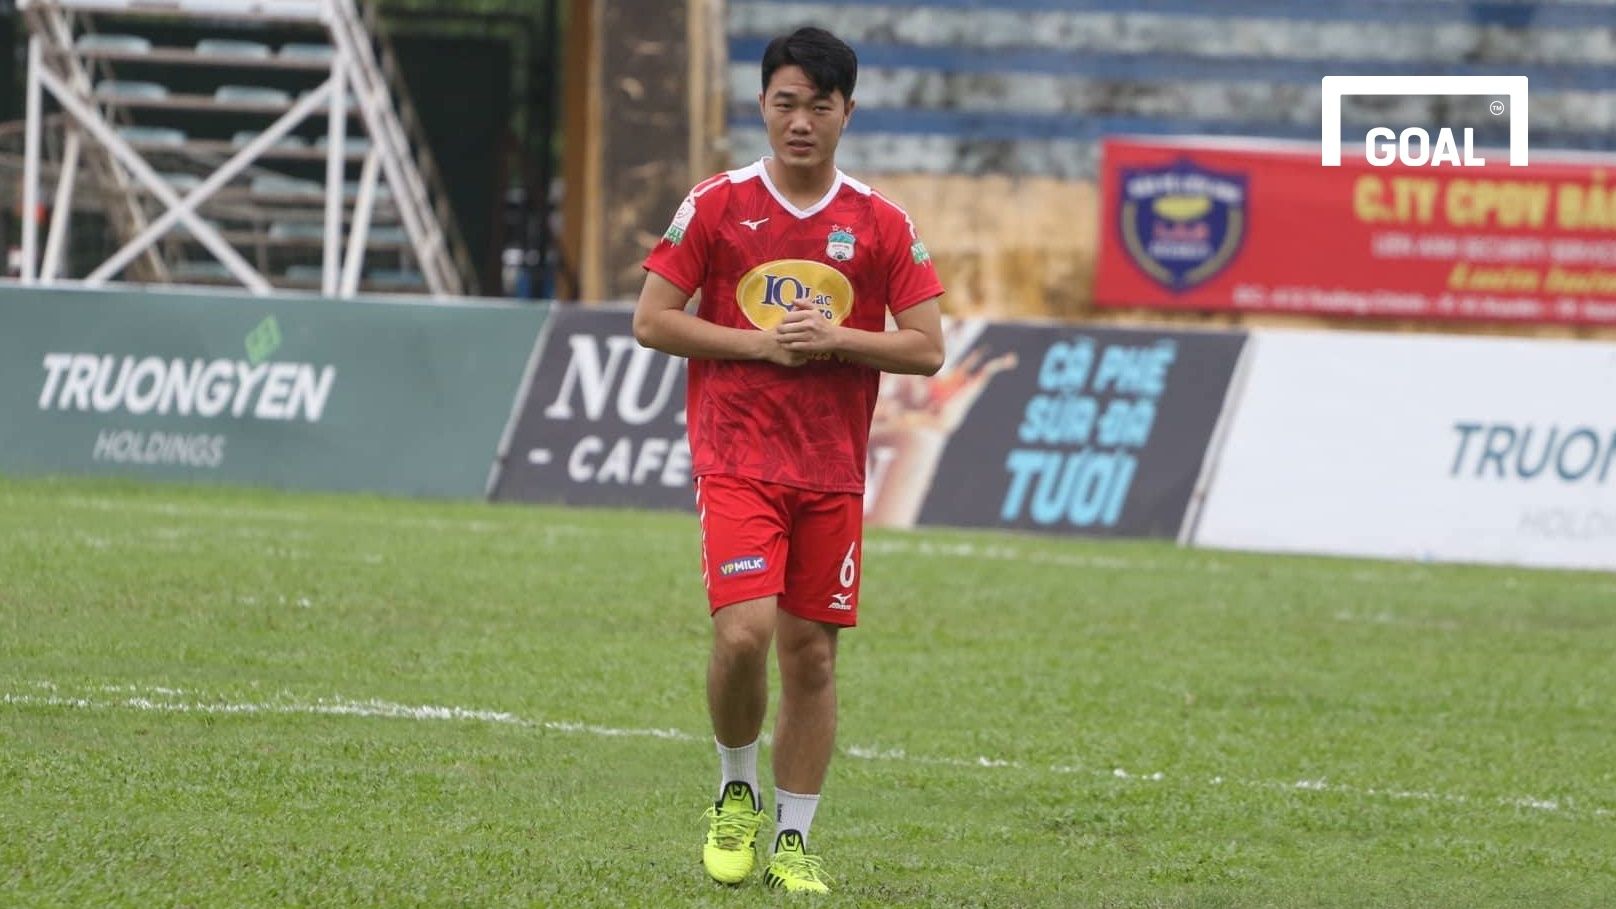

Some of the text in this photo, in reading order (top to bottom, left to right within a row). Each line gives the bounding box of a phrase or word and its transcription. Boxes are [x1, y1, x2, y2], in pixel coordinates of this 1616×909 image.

[761, 275, 804, 312] IQ
[38, 354, 335, 422] TRUONGYEN
[545, 333, 686, 425] NU
[94, 430, 224, 467] HOLDINGS
[839, 541, 856, 588] 6
